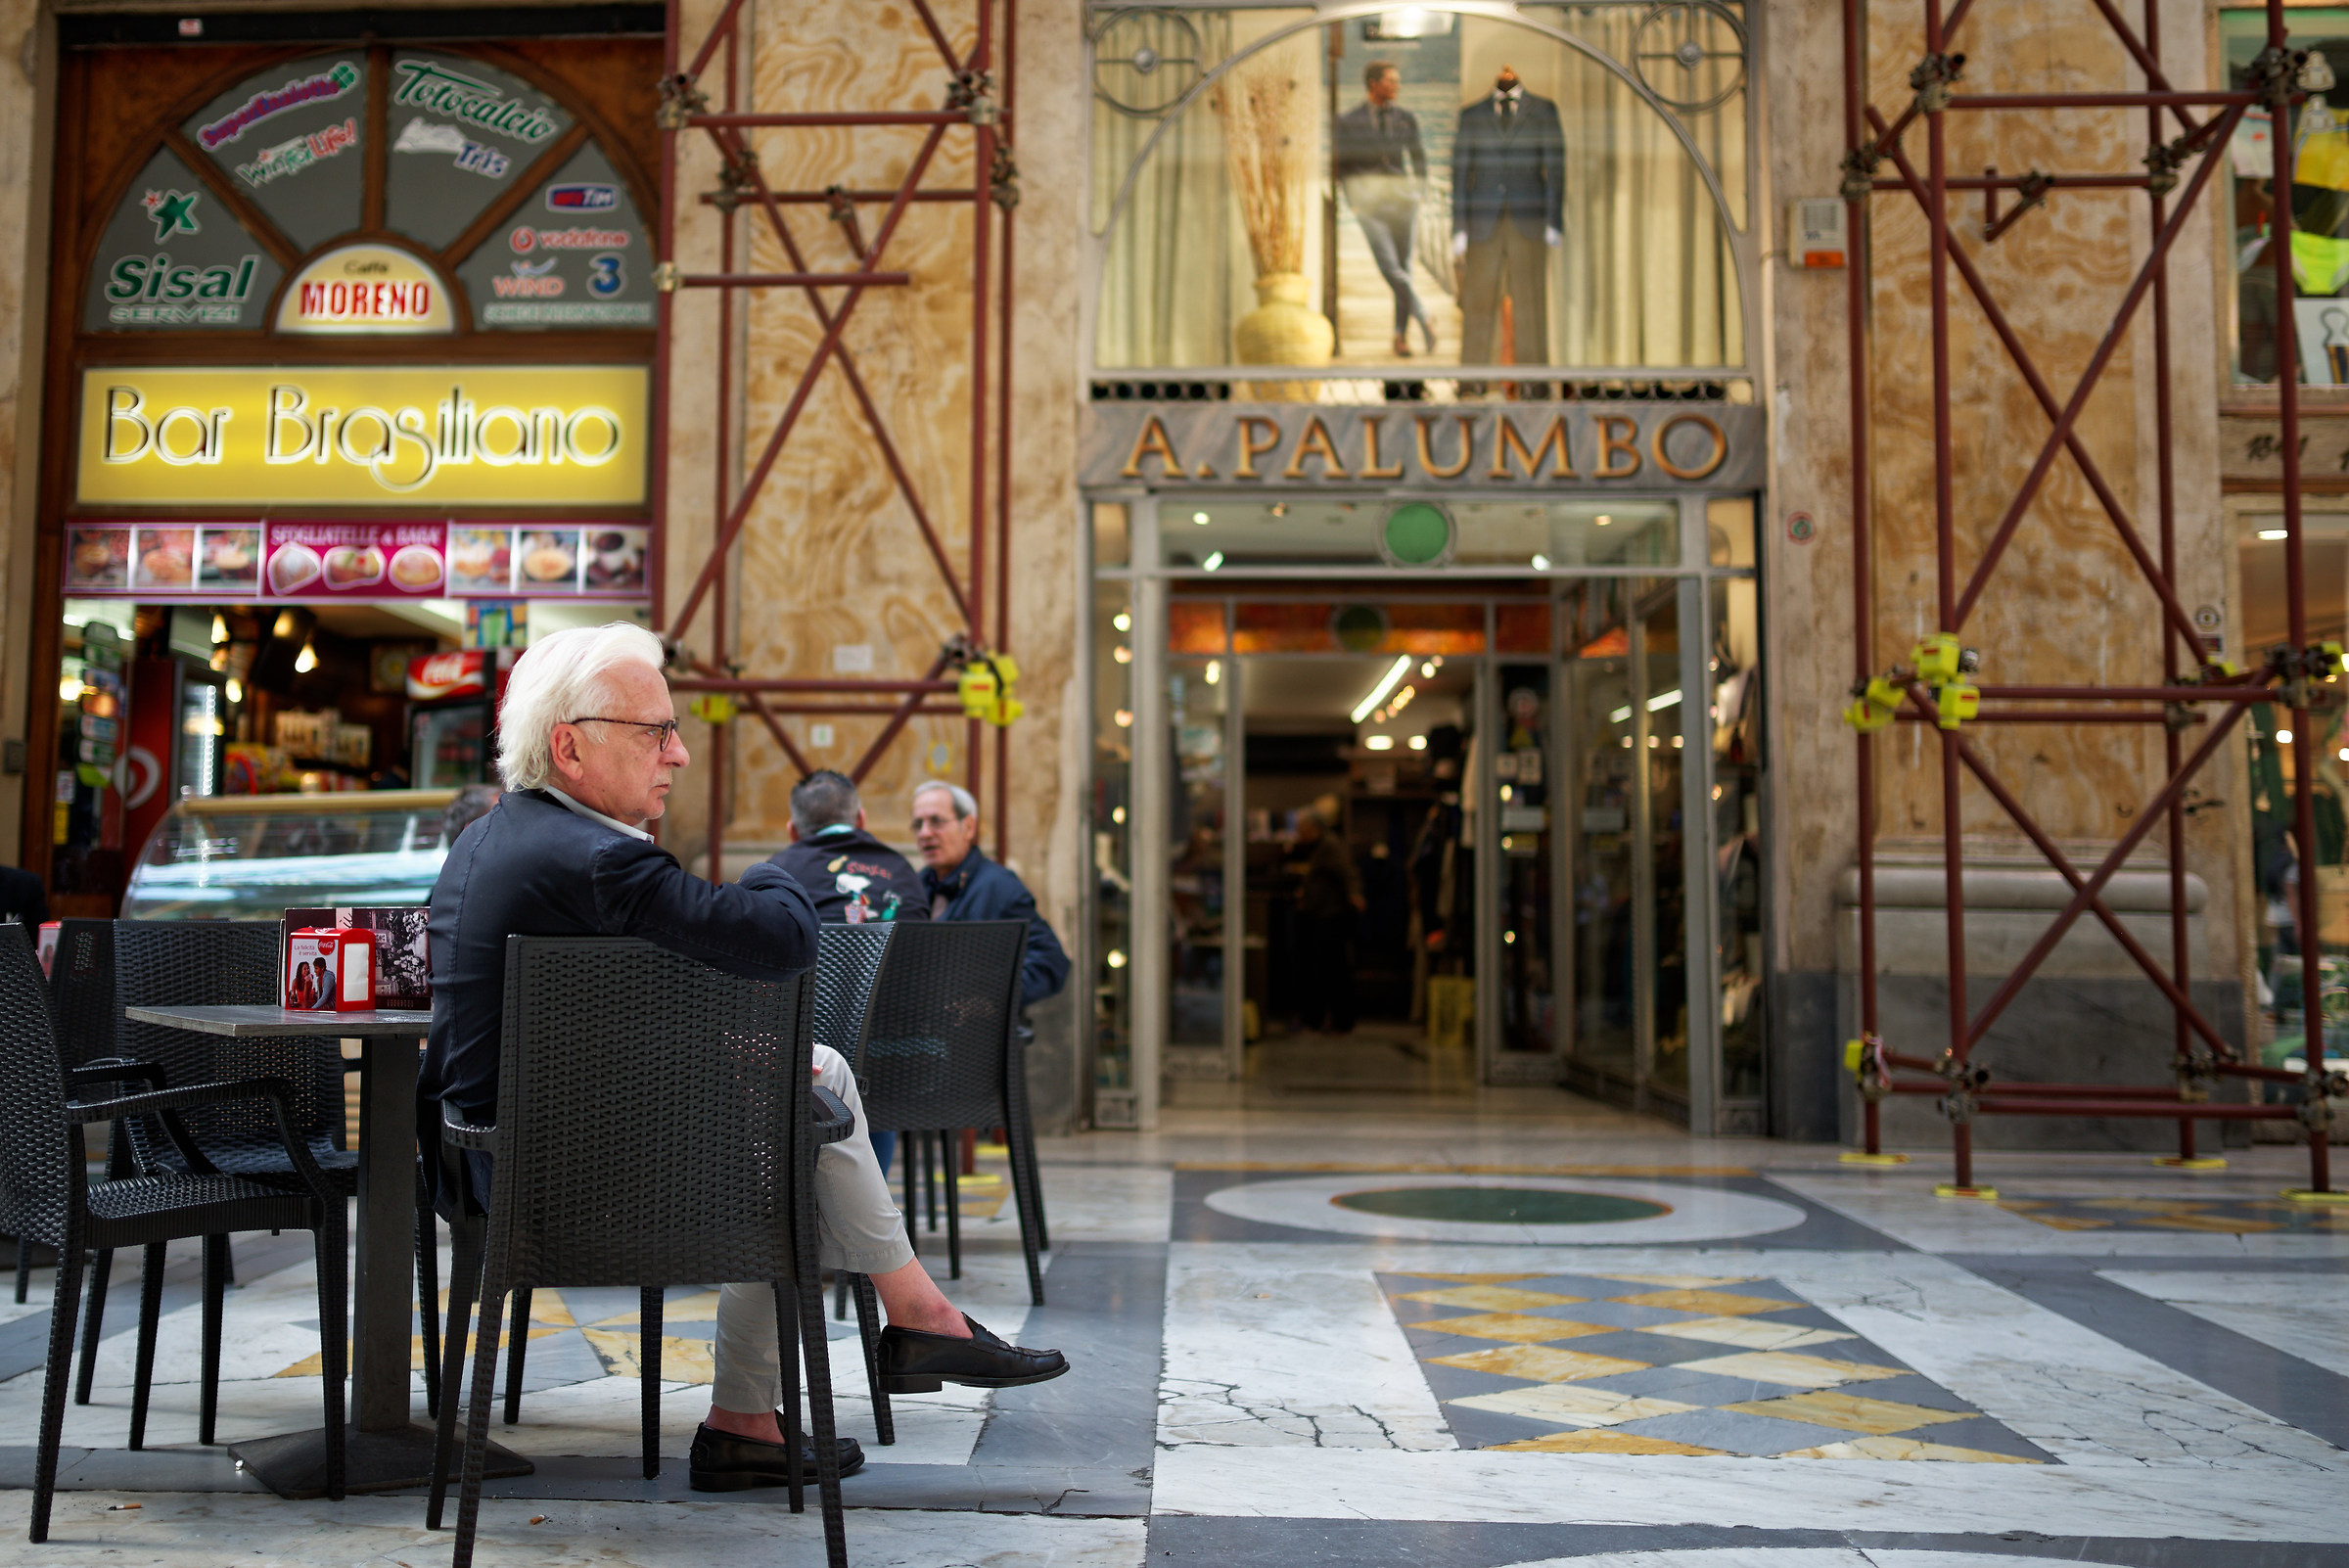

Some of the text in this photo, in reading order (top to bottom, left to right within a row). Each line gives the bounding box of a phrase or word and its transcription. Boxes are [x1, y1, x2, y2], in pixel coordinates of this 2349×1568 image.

[395, 62, 554, 140] Totocalcio
[458, 142, 509, 176] Tris
[539, 228, 628, 248] vodafone
[107, 254, 257, 300] Sisal
[493, 277, 564, 297] WIND
[589, 254, 623, 297] 3
[110, 305, 240, 322] SERVIZI
[300, 281, 431, 318] MORENO
[104, 385, 621, 492] Bar Brasiliano
[1119, 413, 1729, 480] A. PALUMBO
